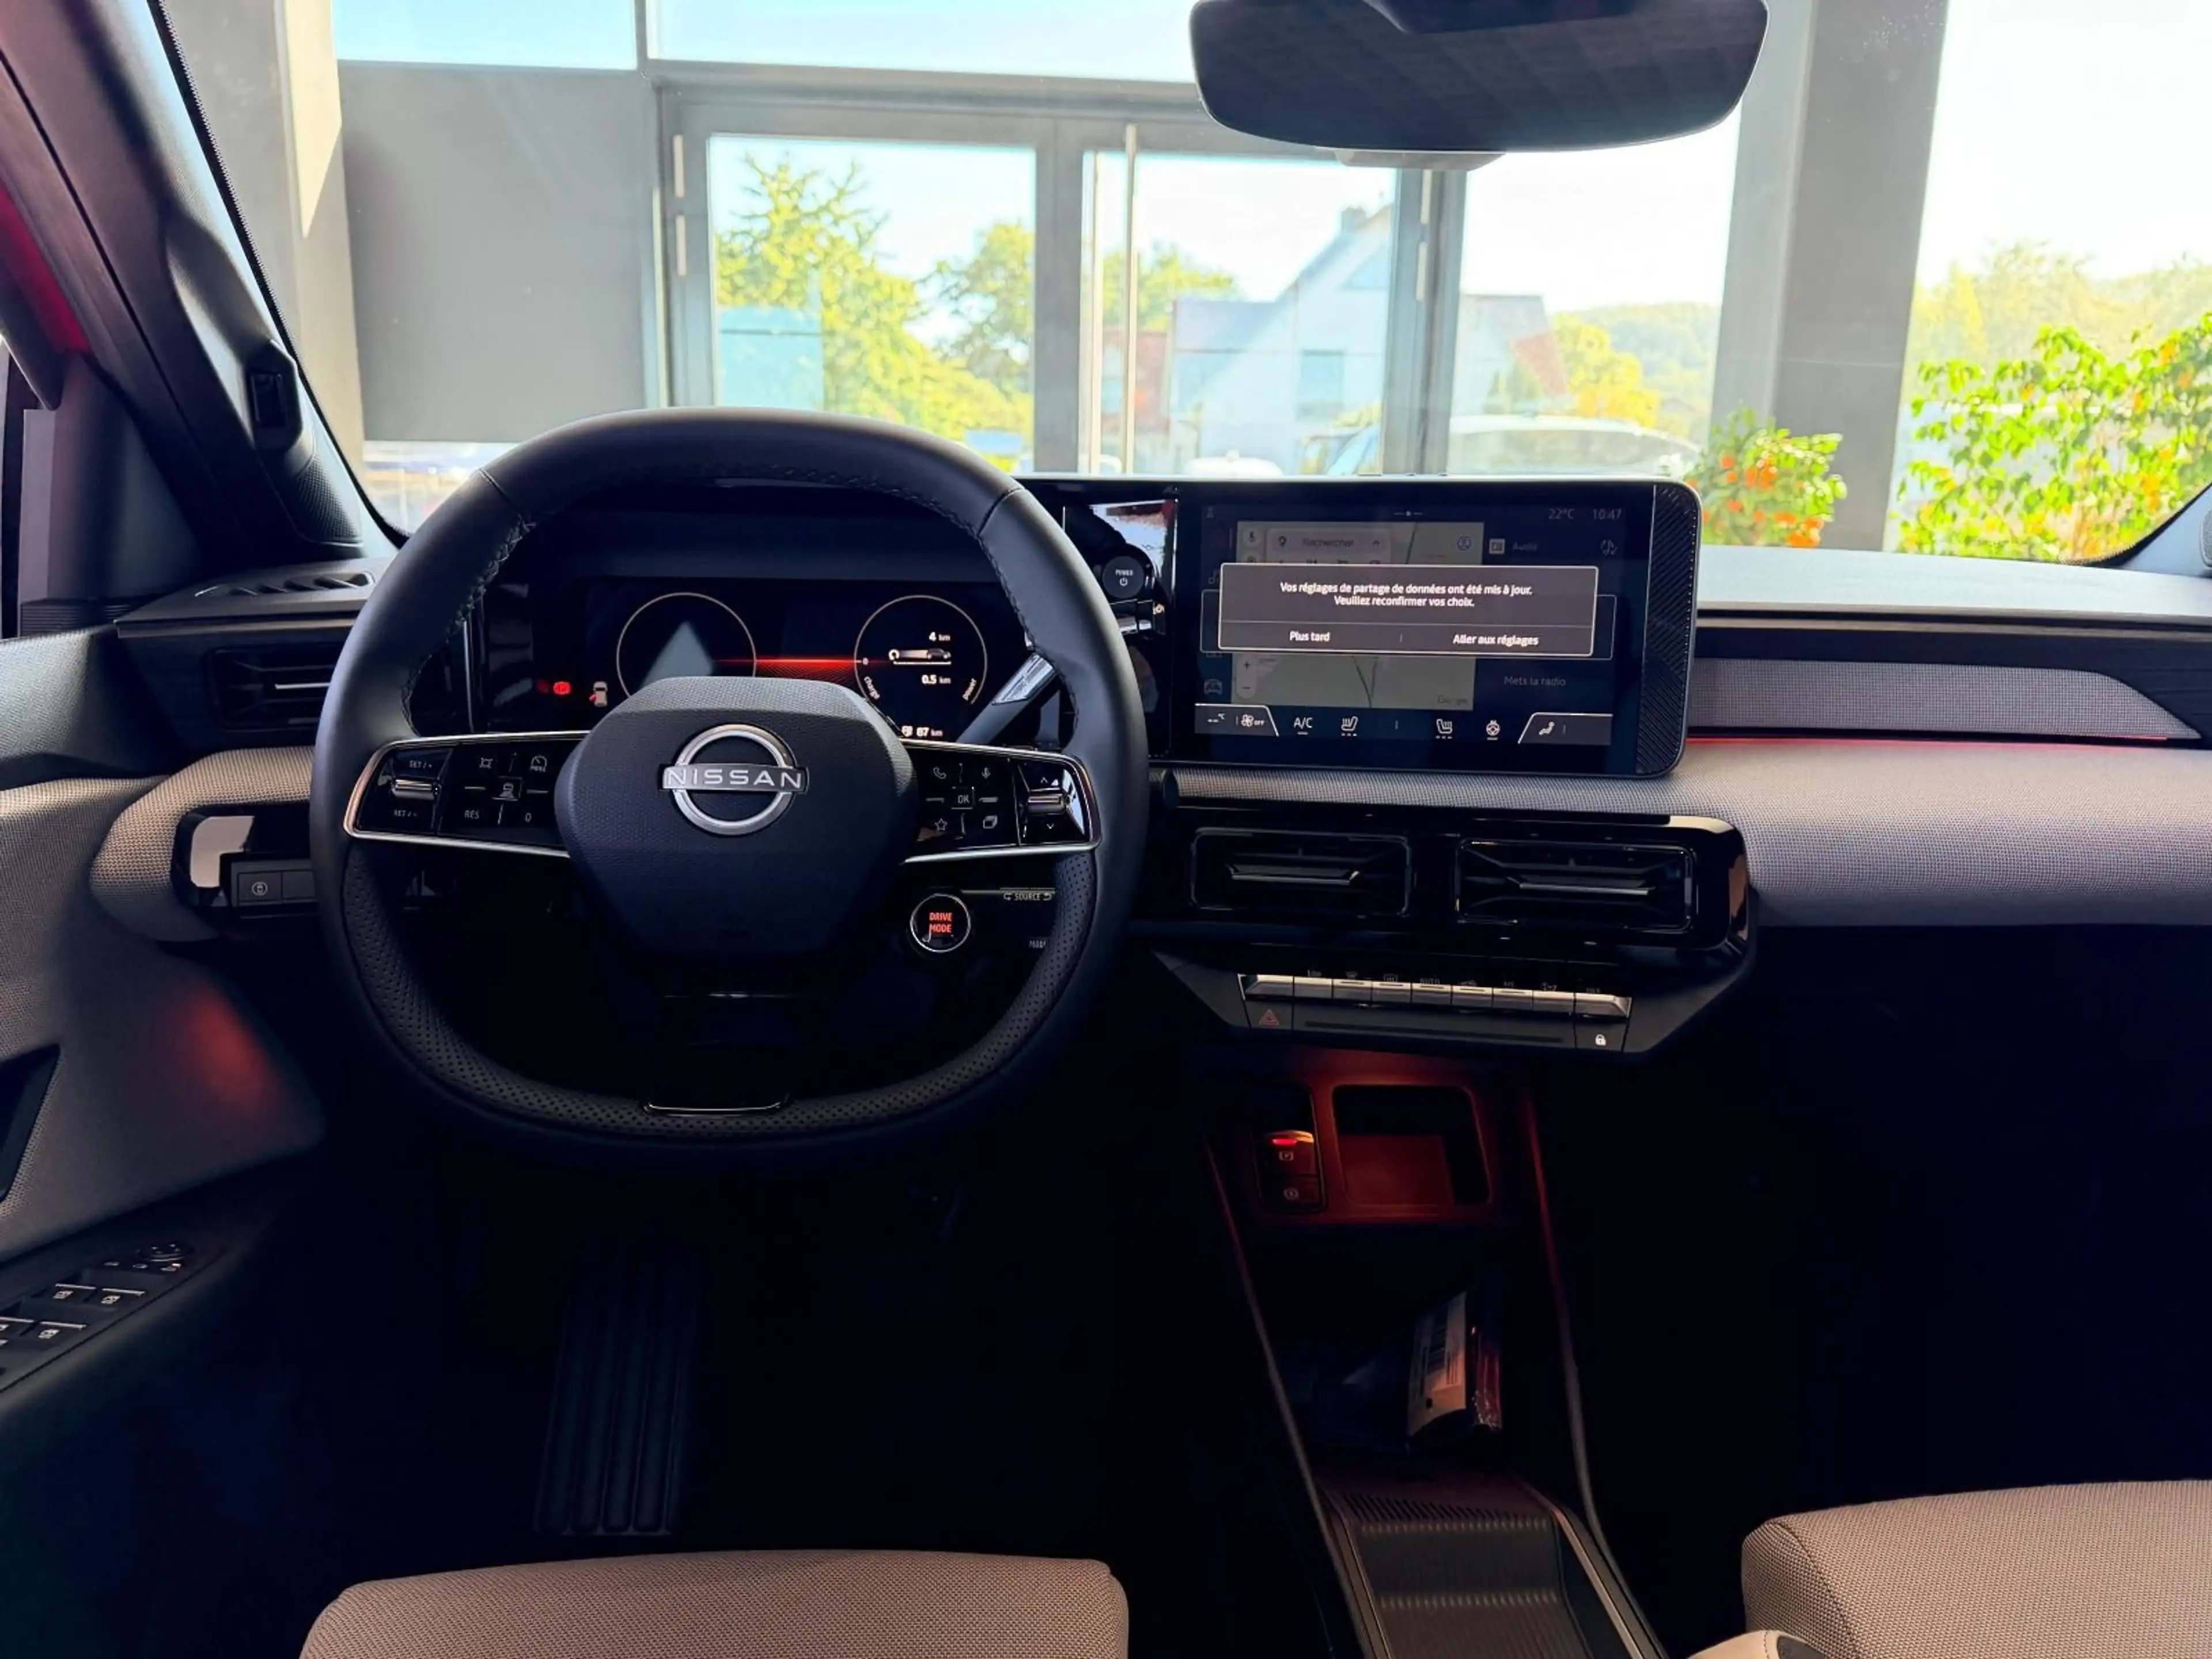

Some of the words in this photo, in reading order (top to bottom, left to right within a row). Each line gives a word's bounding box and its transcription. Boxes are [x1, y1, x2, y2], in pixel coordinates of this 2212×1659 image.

[1280, 582, 1297, 592] Vos
[1298, 582, 1338, 595] réglages
[1339, 583, 1351, 593] de
[1353, 584, 1389, 595] partage
[1392, 584, 1404, 593] de
[1406, 584, 1446, 594] données
[1448, 585, 1464, 594] ont
[1466, 585, 1482, 594] été
[1483, 585, 1501, 595] mis
[1502, 584, 1509, 595] à
[1510, 585, 1532, 597] jour.
[1334, 596, 1370, 605] Veuillez
[1372, 596, 1426, 606] reconfirmer
[1429, 598, 1445, 606] vos
[1447, 597, 1475, 607] choix.
[929, 631, 937, 642] 4
[1289, 631, 1309, 641] Plus
[1310, 631, 1331, 642] tard
[1453, 634, 1475, 644] Aller
[1478, 636, 1495, 645] aux
[1497, 634, 1539, 647] réglages
[922, 675, 937, 684] 0.5
[1503, 676, 1527, 686] Mets
[1294, 717, 1313, 729] A/C
[931, 728, 943, 737] km
[668, 769, 801, 789] NISSAN
[958, 795, 970, 804] OK
[1014, 893, 1041, 901] SOURCE
[929, 912, 953, 921] DRIVE
[930, 923, 952, 933] MODE
